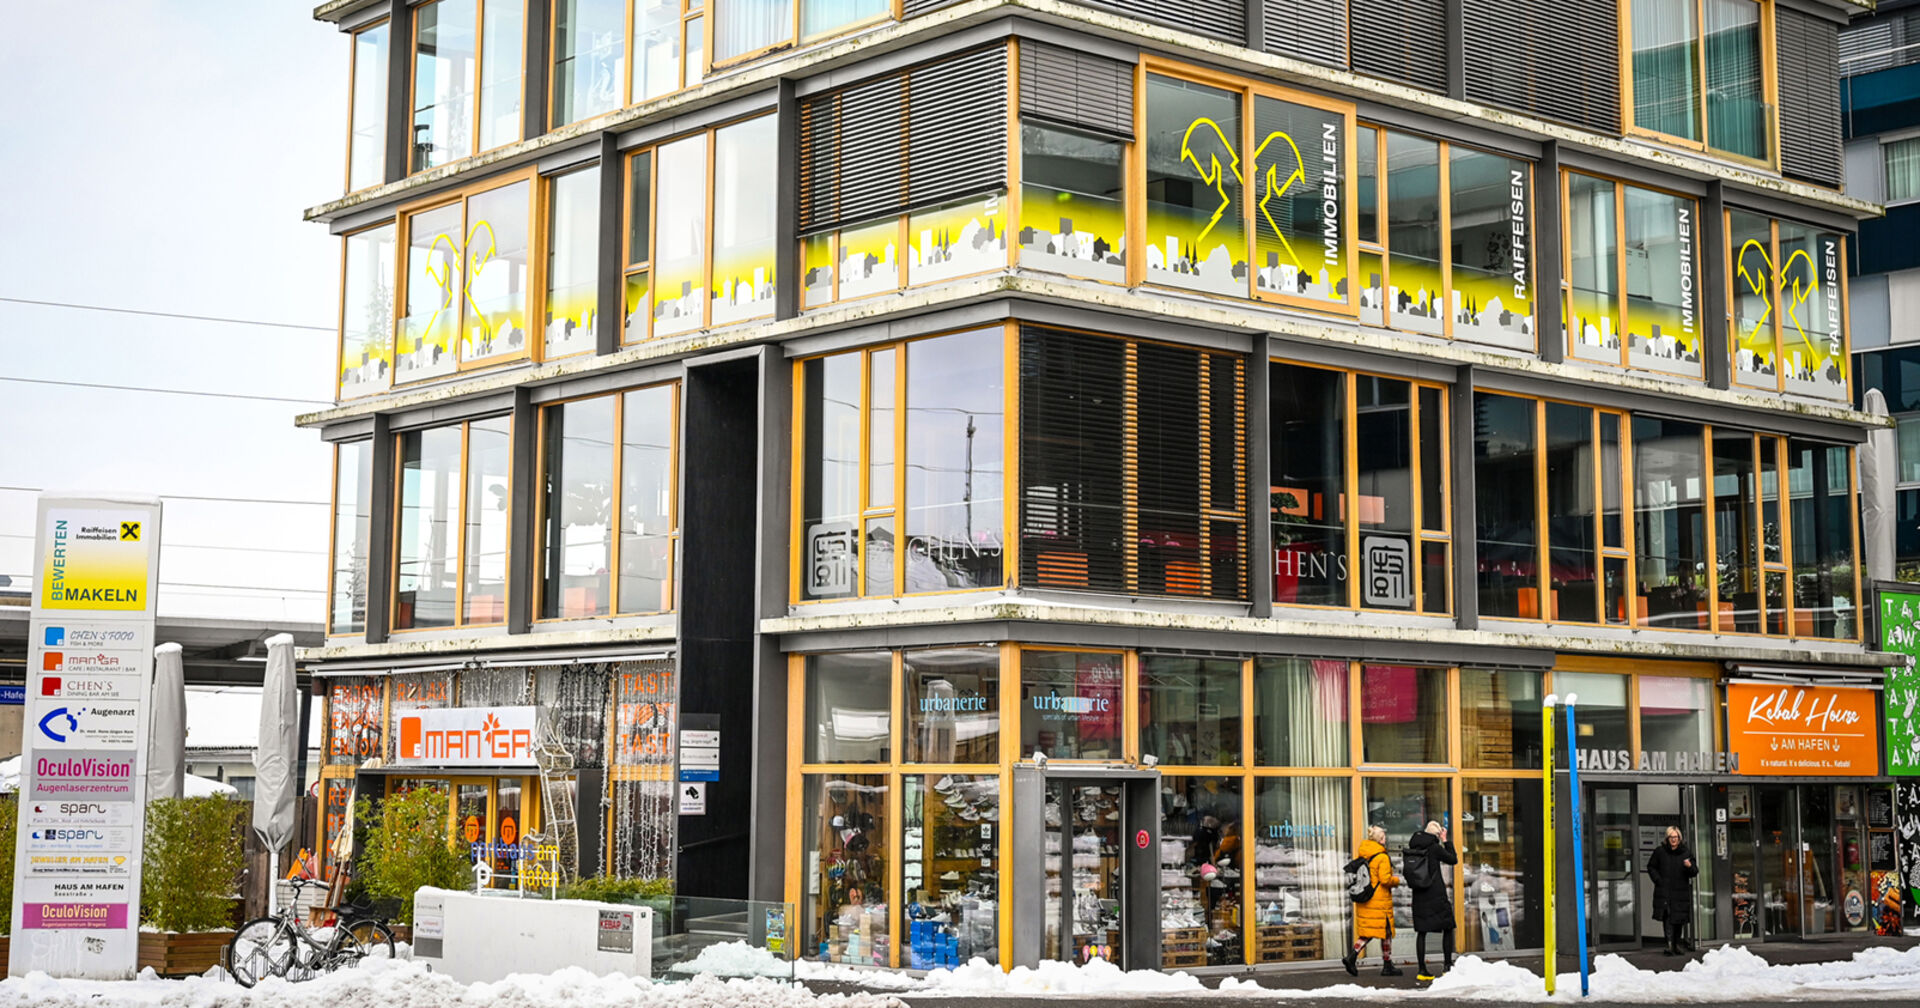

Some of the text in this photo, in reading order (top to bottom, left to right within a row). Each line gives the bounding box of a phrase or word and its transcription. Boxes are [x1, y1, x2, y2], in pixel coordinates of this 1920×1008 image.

[1322, 123, 1338, 265] IMMOBILIEN
[1511, 170, 1526, 300] RAIFFEISEN
[1679, 208, 1693, 333] IMMOBILIEN
[1825, 241, 1840, 356] RAIFFEISEN
[51, 520, 68, 600] BEWERTEN
[65, 588, 137, 602] MAKELN
[333, 685, 381, 704] ENJOY
[397, 681, 448, 701] RELAX
[621, 672, 676, 695] TAST
[1, 690, 25, 700] -Hafe
[920, 691, 986, 711] urbanerie
[1033, 690, 1109, 712] urbanerie
[91, 708, 135, 717] Augenarzt
[1747, 689, 1860, 731] Kebab House
[621, 733, 675, 755] TAST
[1781, 739, 1830, 751] AM HAFEN
[1576, 749, 1630, 771] HAUS
[1638, 751, 1667, 771] AM
[37, 783, 129, 794] Augenlaserzentrum
[1269, 819, 1335, 838] urbanerie
[471, 838, 560, 862] parkhaus am
[518, 859, 560, 887] hafen
